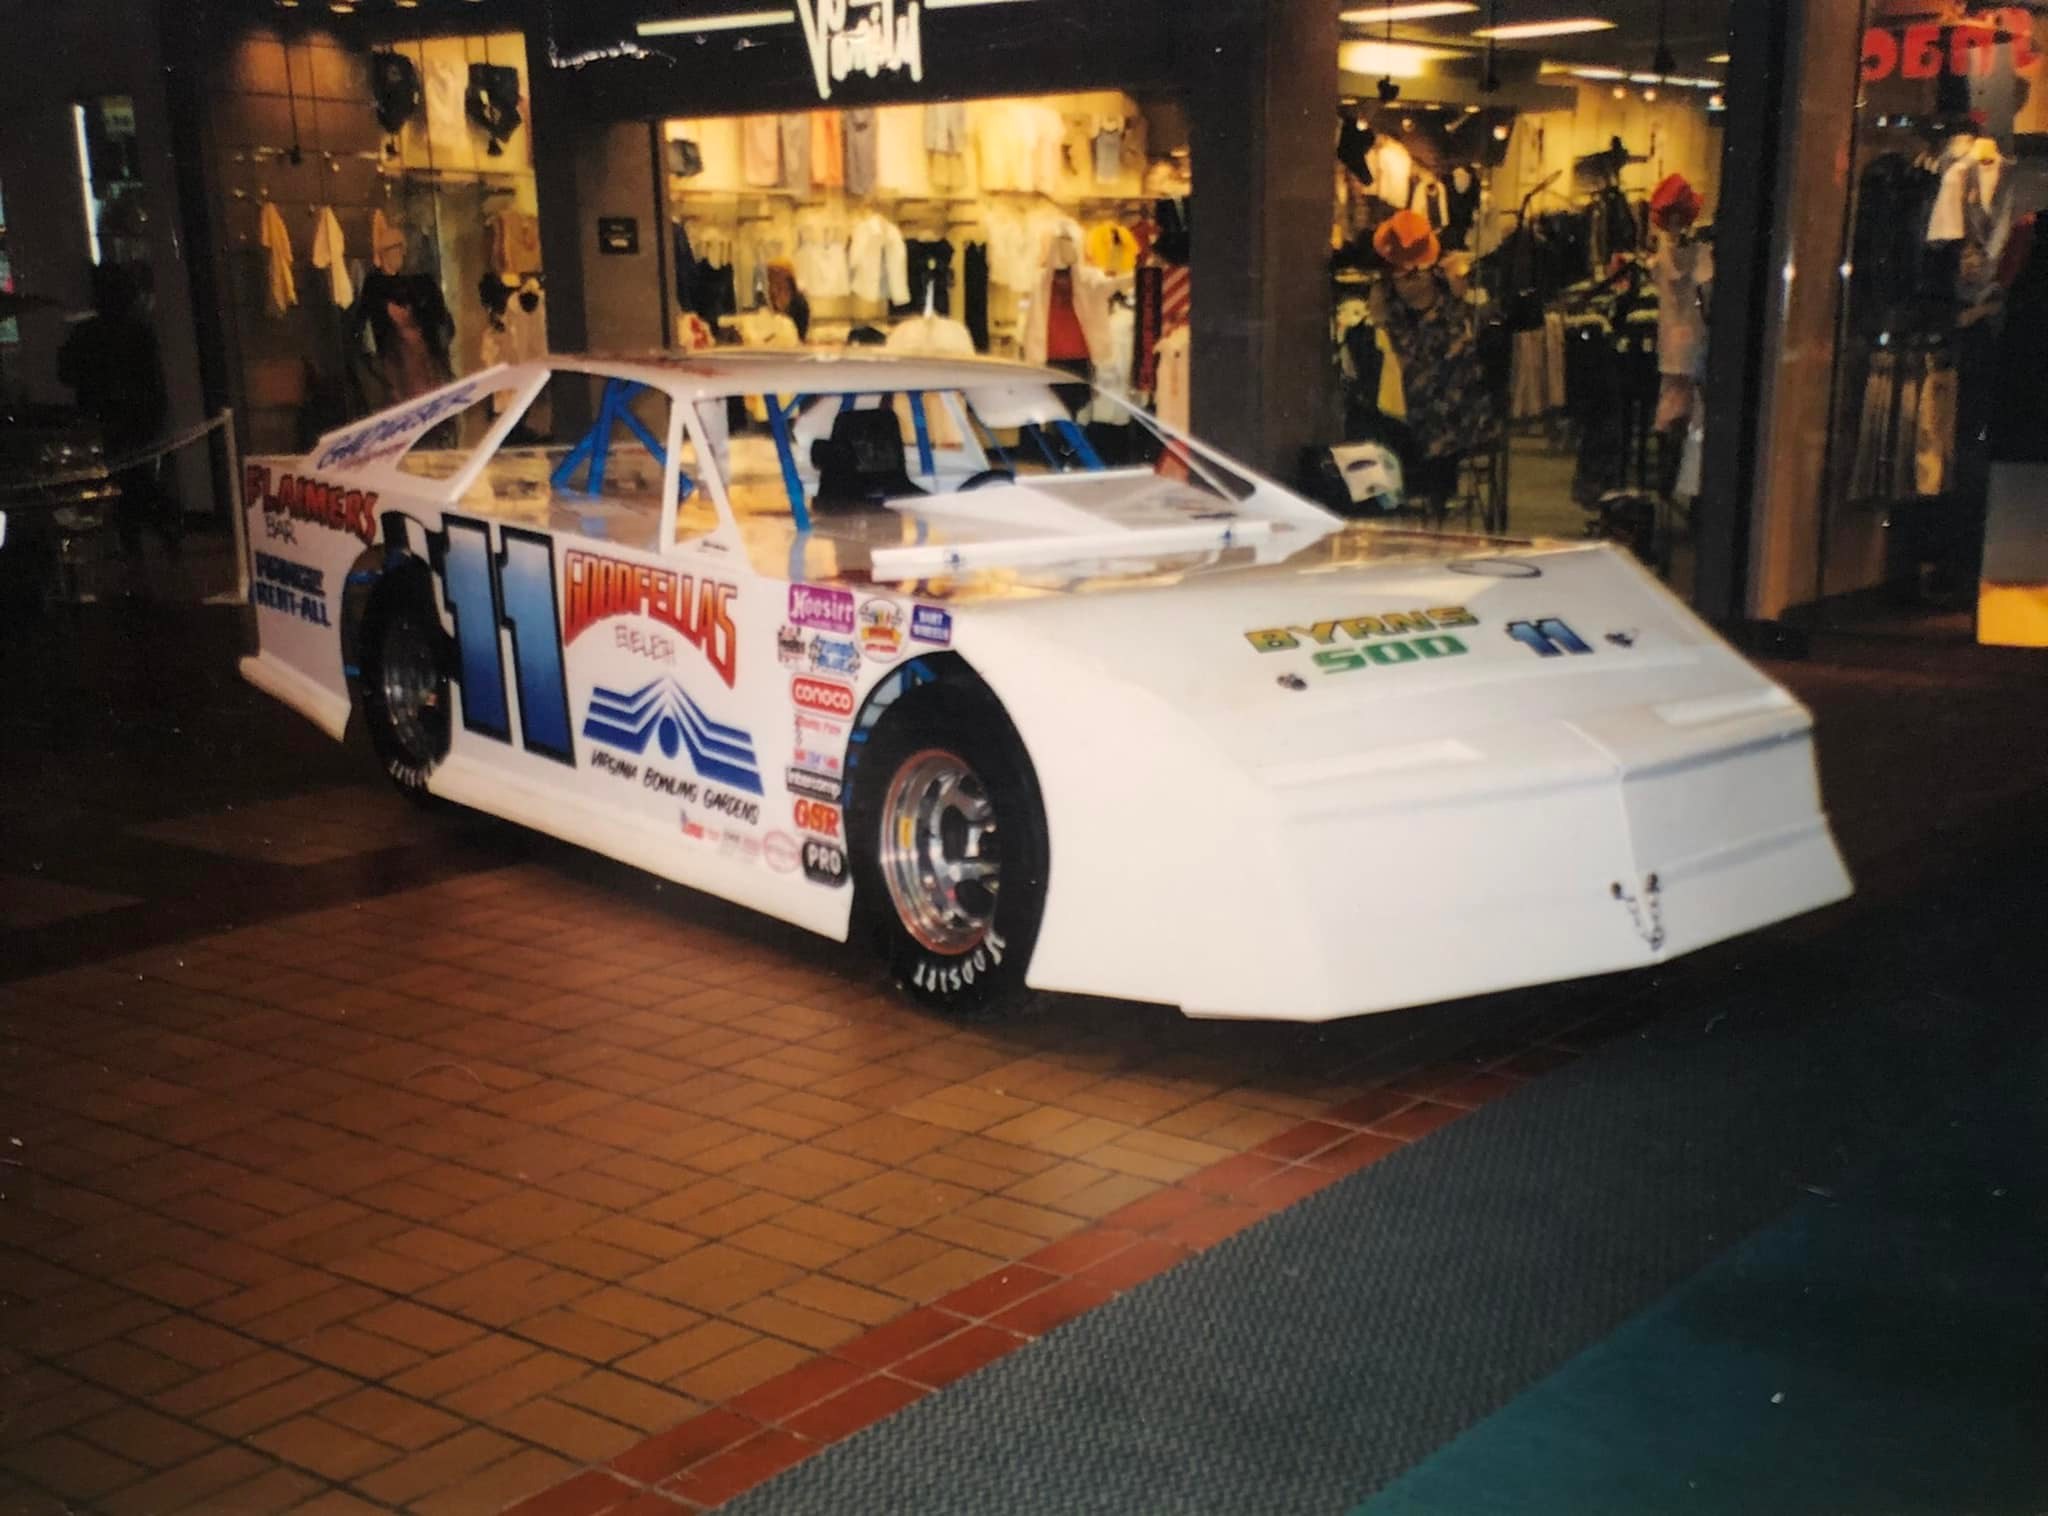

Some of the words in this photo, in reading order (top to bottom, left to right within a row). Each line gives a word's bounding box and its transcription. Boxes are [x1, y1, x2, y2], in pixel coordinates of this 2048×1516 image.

[428, 512, 577, 770] 11
[564, 549, 738, 690] GOODFELLAS
[1244, 606, 1479, 653] BYRNS
[1506, 617, 1594, 658] 11
[1312, 634, 1468, 674] 500
[642, 766, 698, 804] BOWLING
[702, 786, 760, 826] GARDENS
[807, 842, 842, 875] PRO
